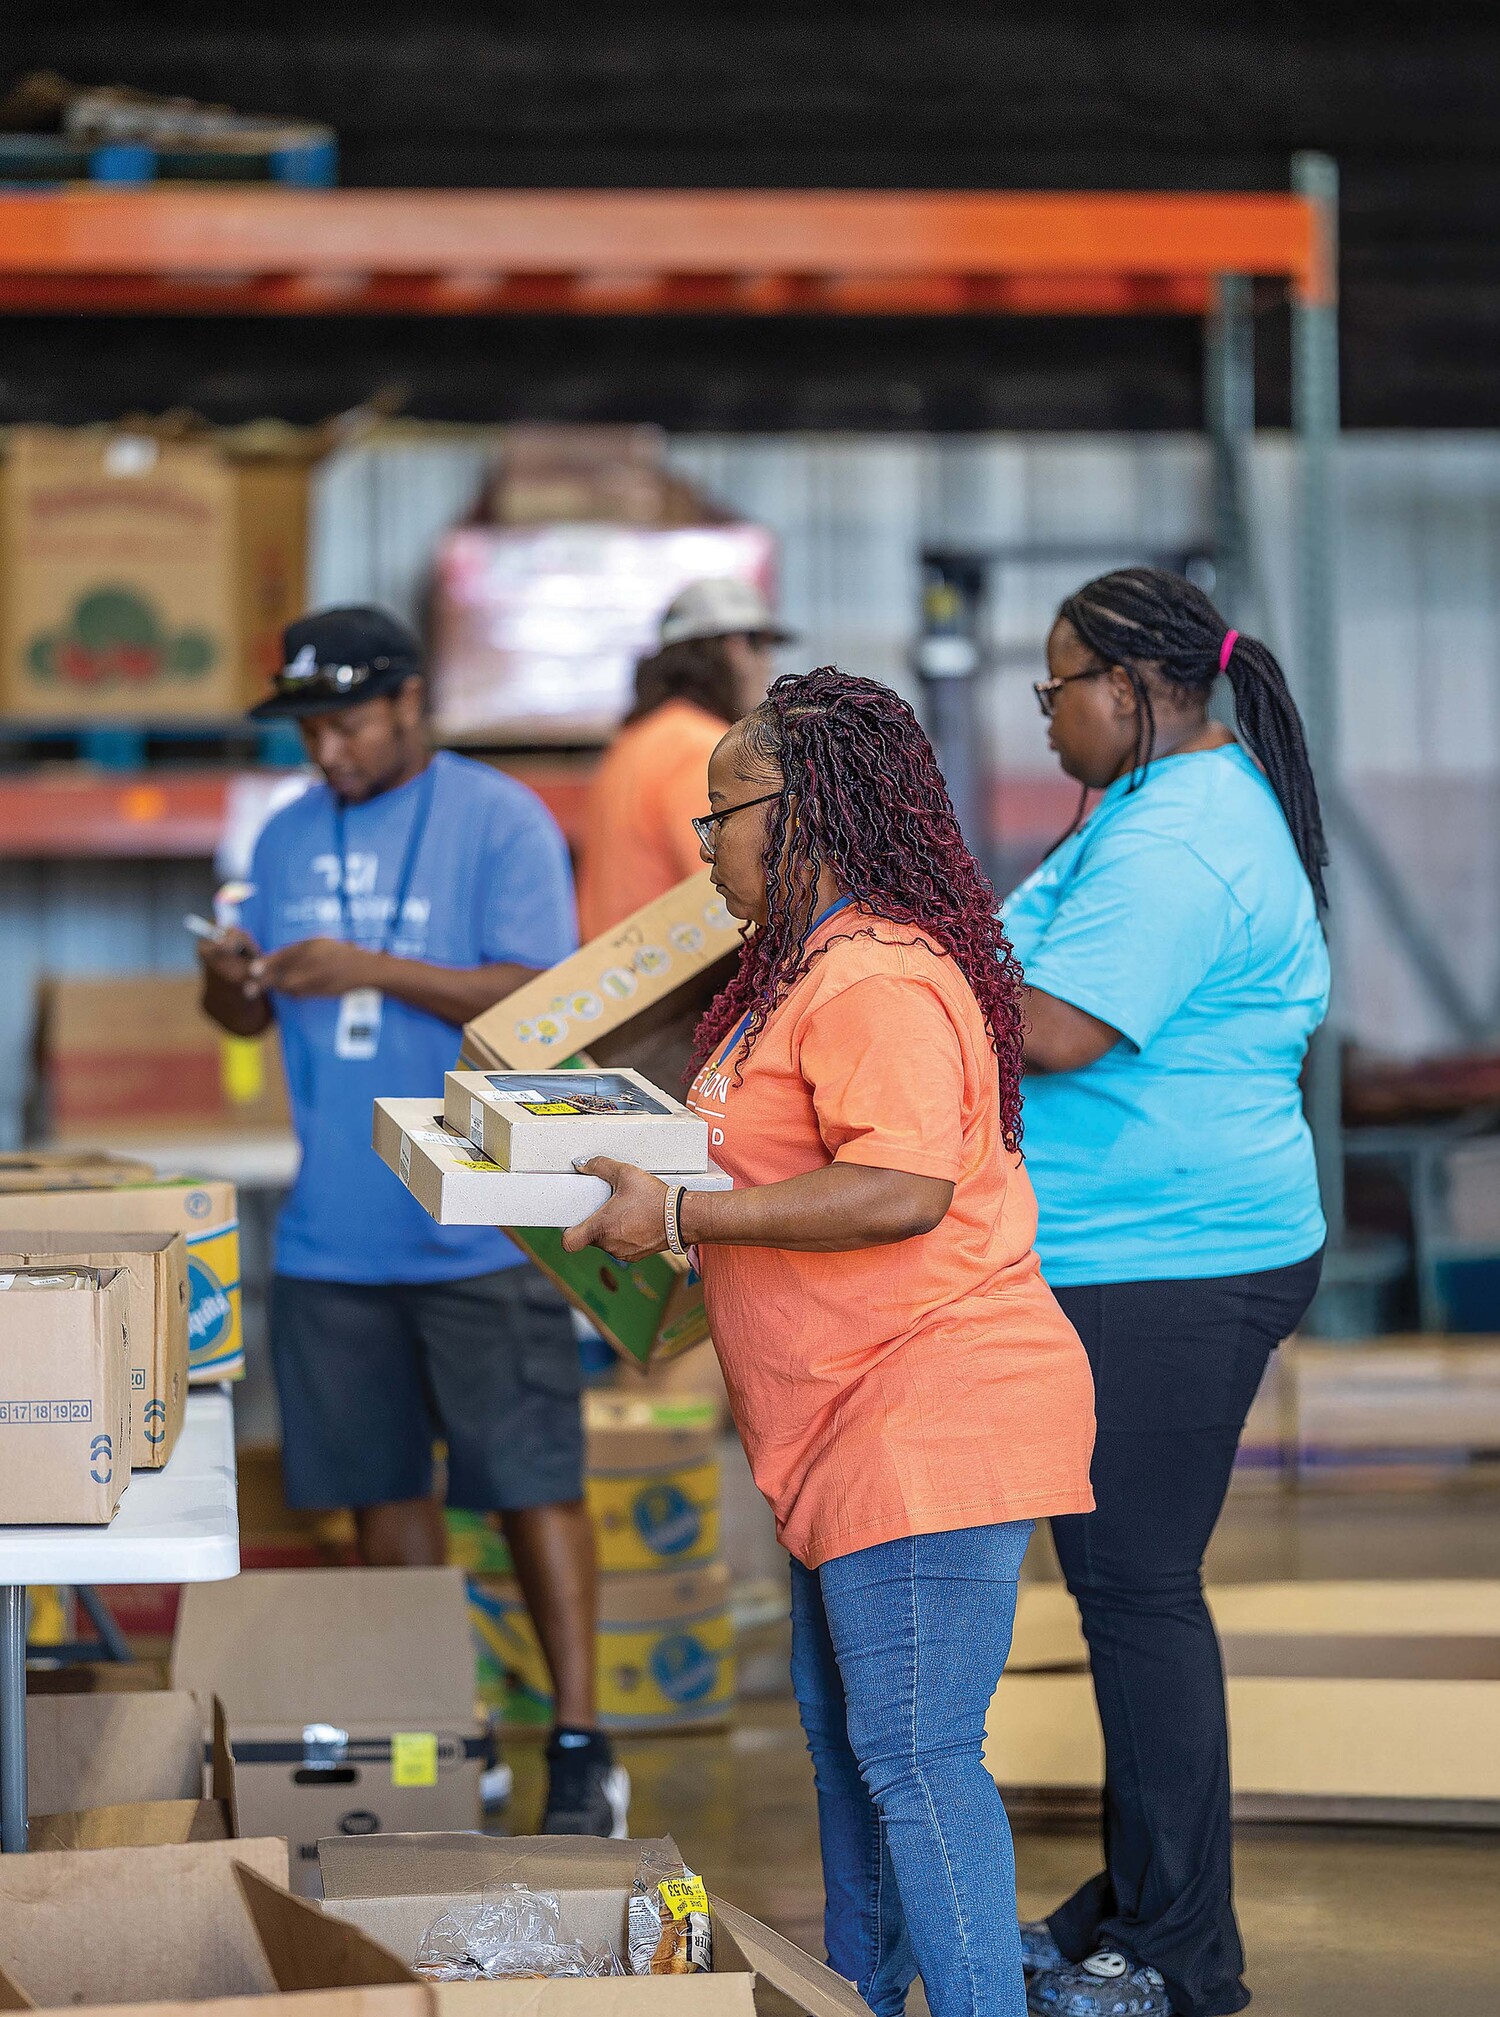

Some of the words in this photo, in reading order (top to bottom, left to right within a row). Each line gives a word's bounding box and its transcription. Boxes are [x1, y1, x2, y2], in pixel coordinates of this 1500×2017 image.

[711, 1127, 725, 1146] D
[666, 1209, 676, 1241] LOVES
[12, 1406, 28, 1419] 17
[33, 1405, 49, 1419] 18
[53, 1405, 69, 1418] 19
[72, 1404, 89, 1418] 20
